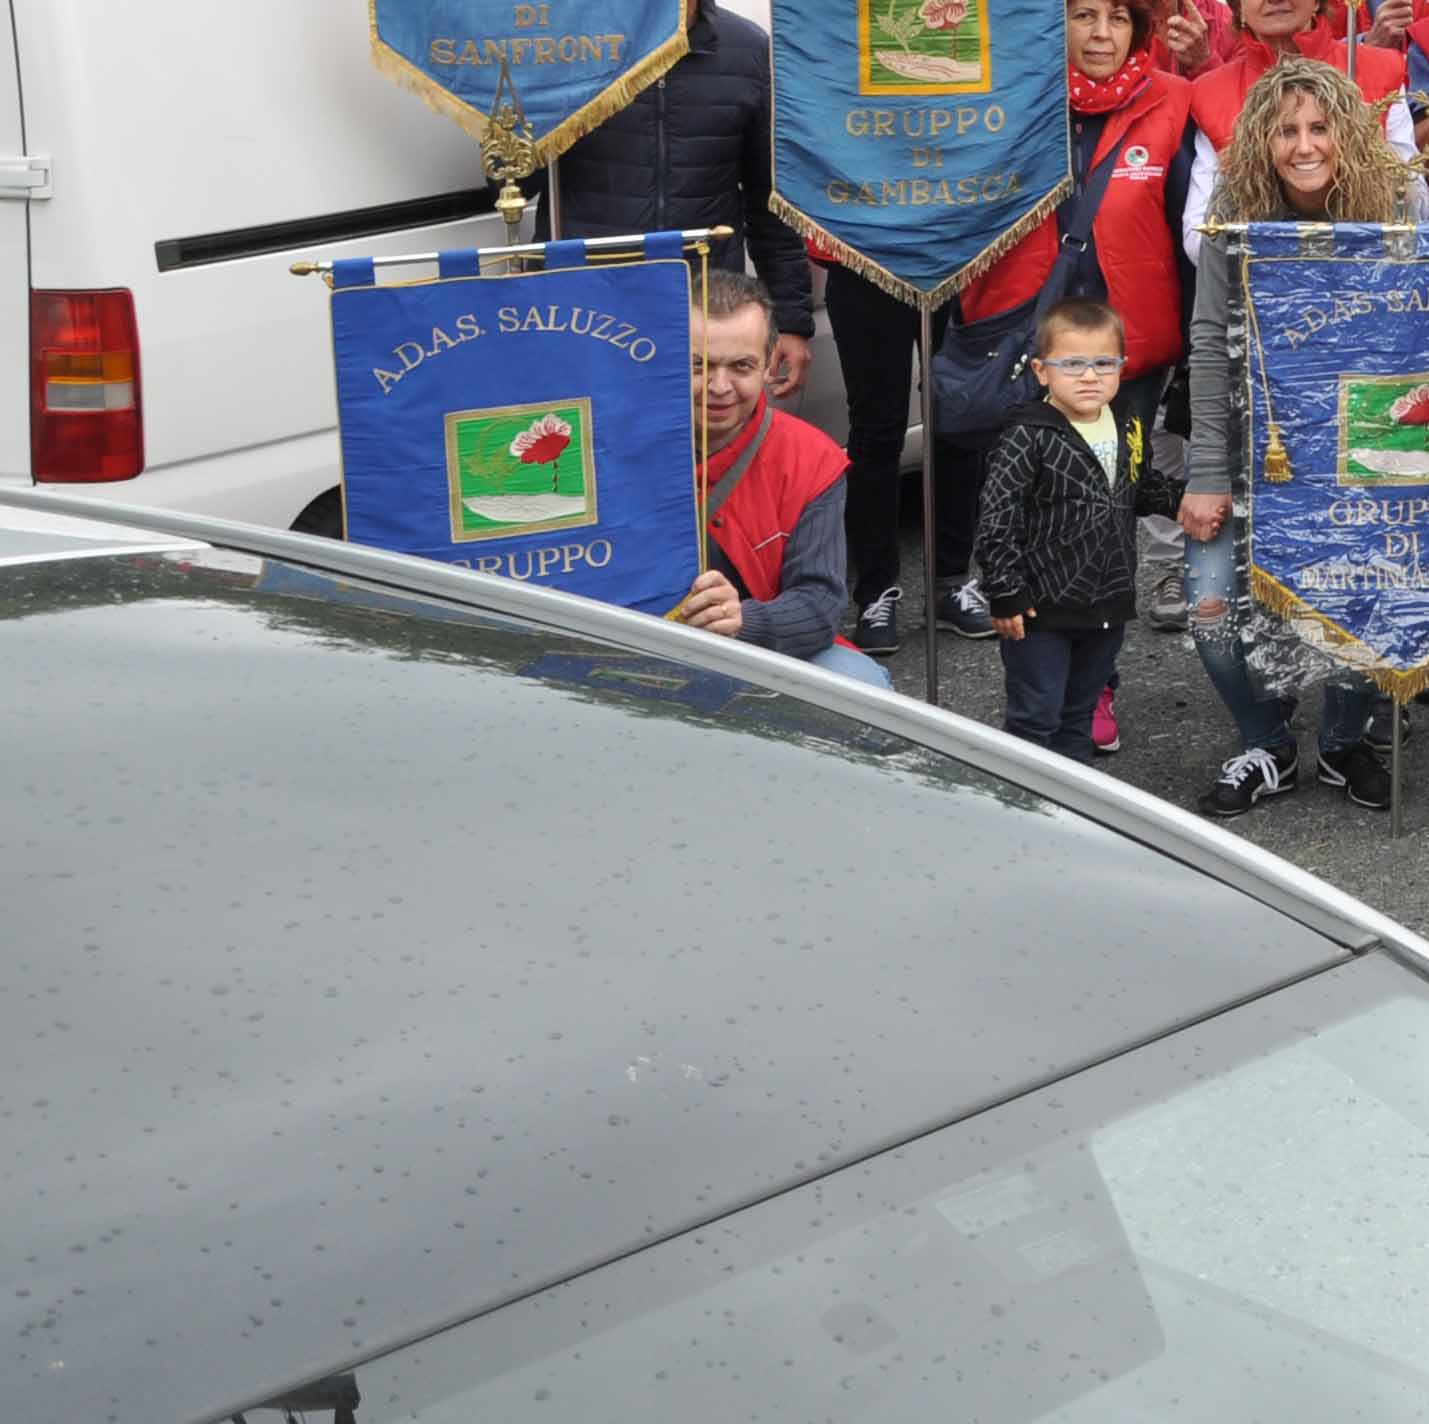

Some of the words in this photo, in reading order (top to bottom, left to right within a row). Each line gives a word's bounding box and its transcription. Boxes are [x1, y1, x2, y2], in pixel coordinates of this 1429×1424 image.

[514, 5, 550, 27] DI
[431, 34, 625, 65] SANFRONT
[845, 105, 1006, 136] GRUPPO
[912, 148, 943, 169] DI
[826, 173, 1022, 206] GAMBASCA
[372, 314, 486, 395] A.D.A.S.
[497, 306, 656, 363] SALUZZO
[1385, 532, 1420, 558] DI
